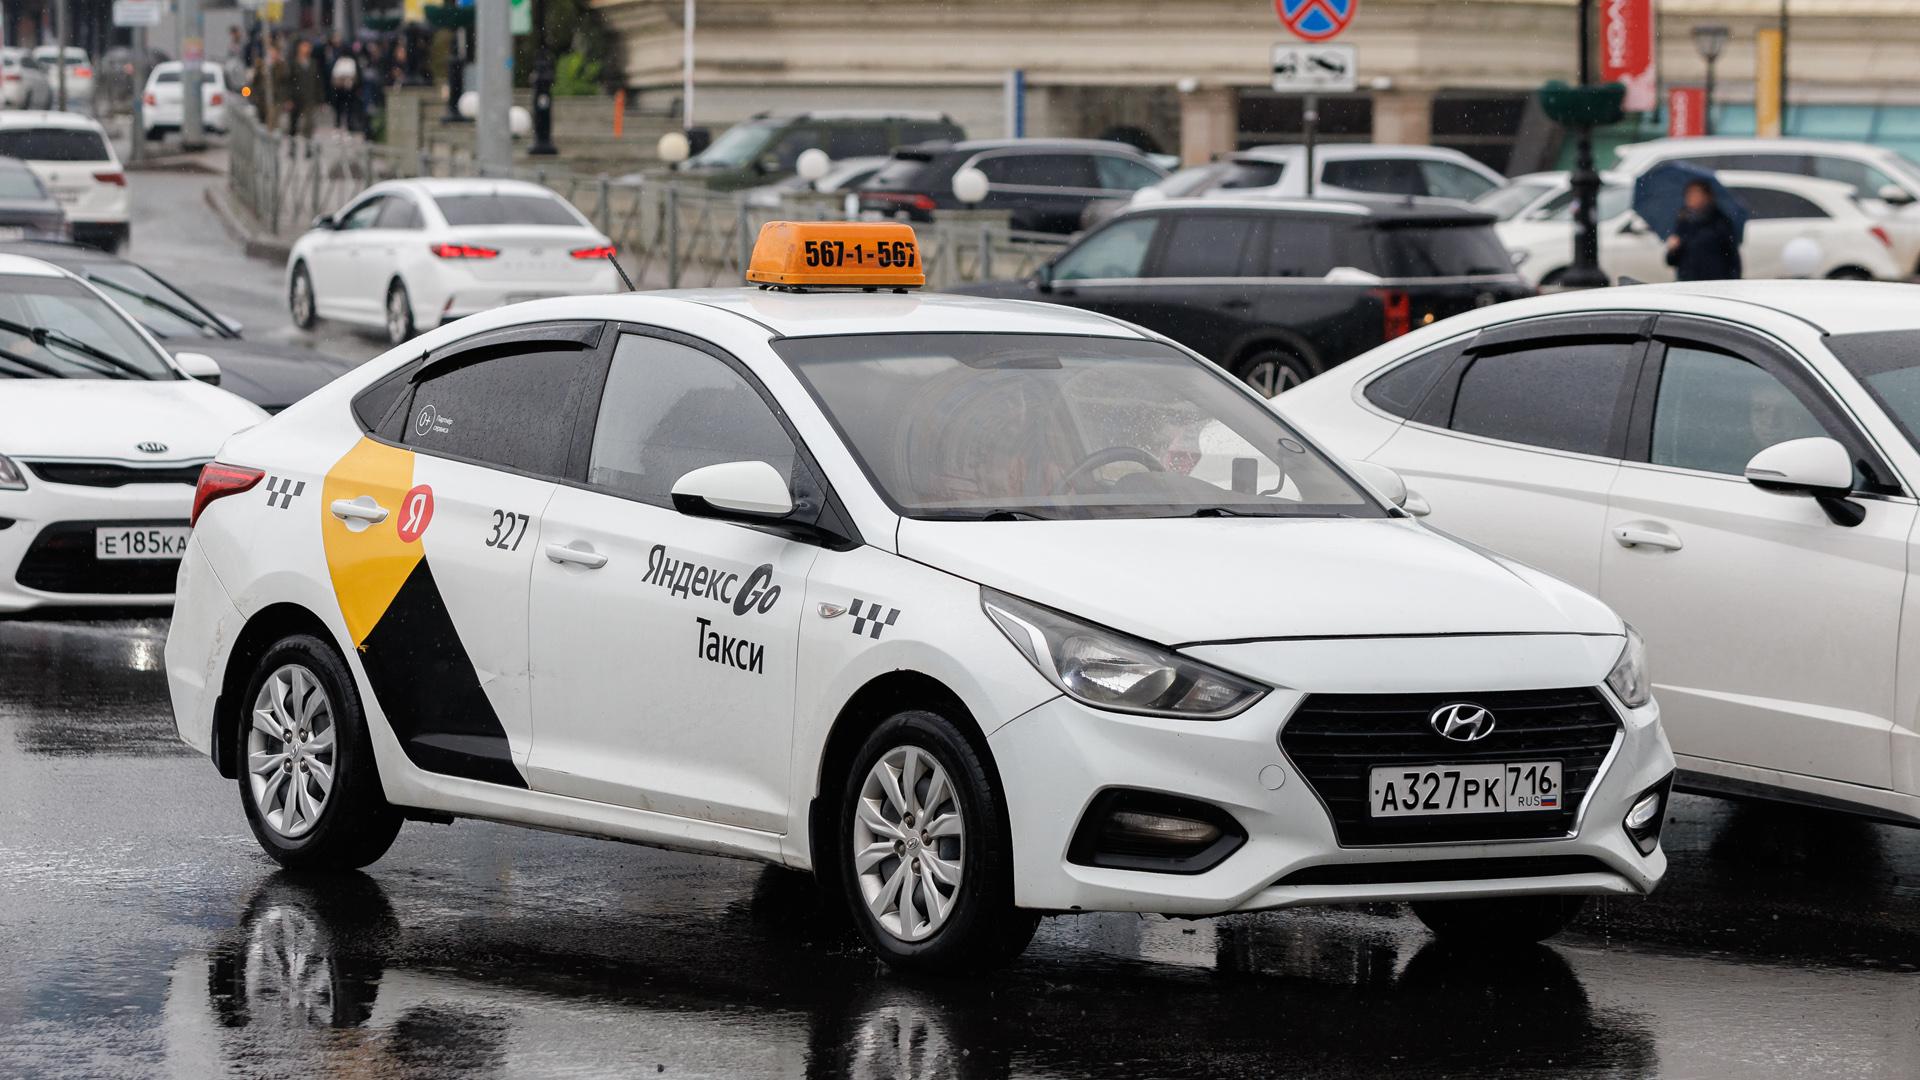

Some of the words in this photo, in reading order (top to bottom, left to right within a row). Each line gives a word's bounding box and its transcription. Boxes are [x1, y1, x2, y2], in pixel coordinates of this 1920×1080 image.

[805, 241, 914, 267] 567-1-567
[485, 509, 530, 552] 327
[696, 616, 764, 675] Такси
[1508, 765, 1552, 796] 716
[1518, 795, 1540, 807] RUS
